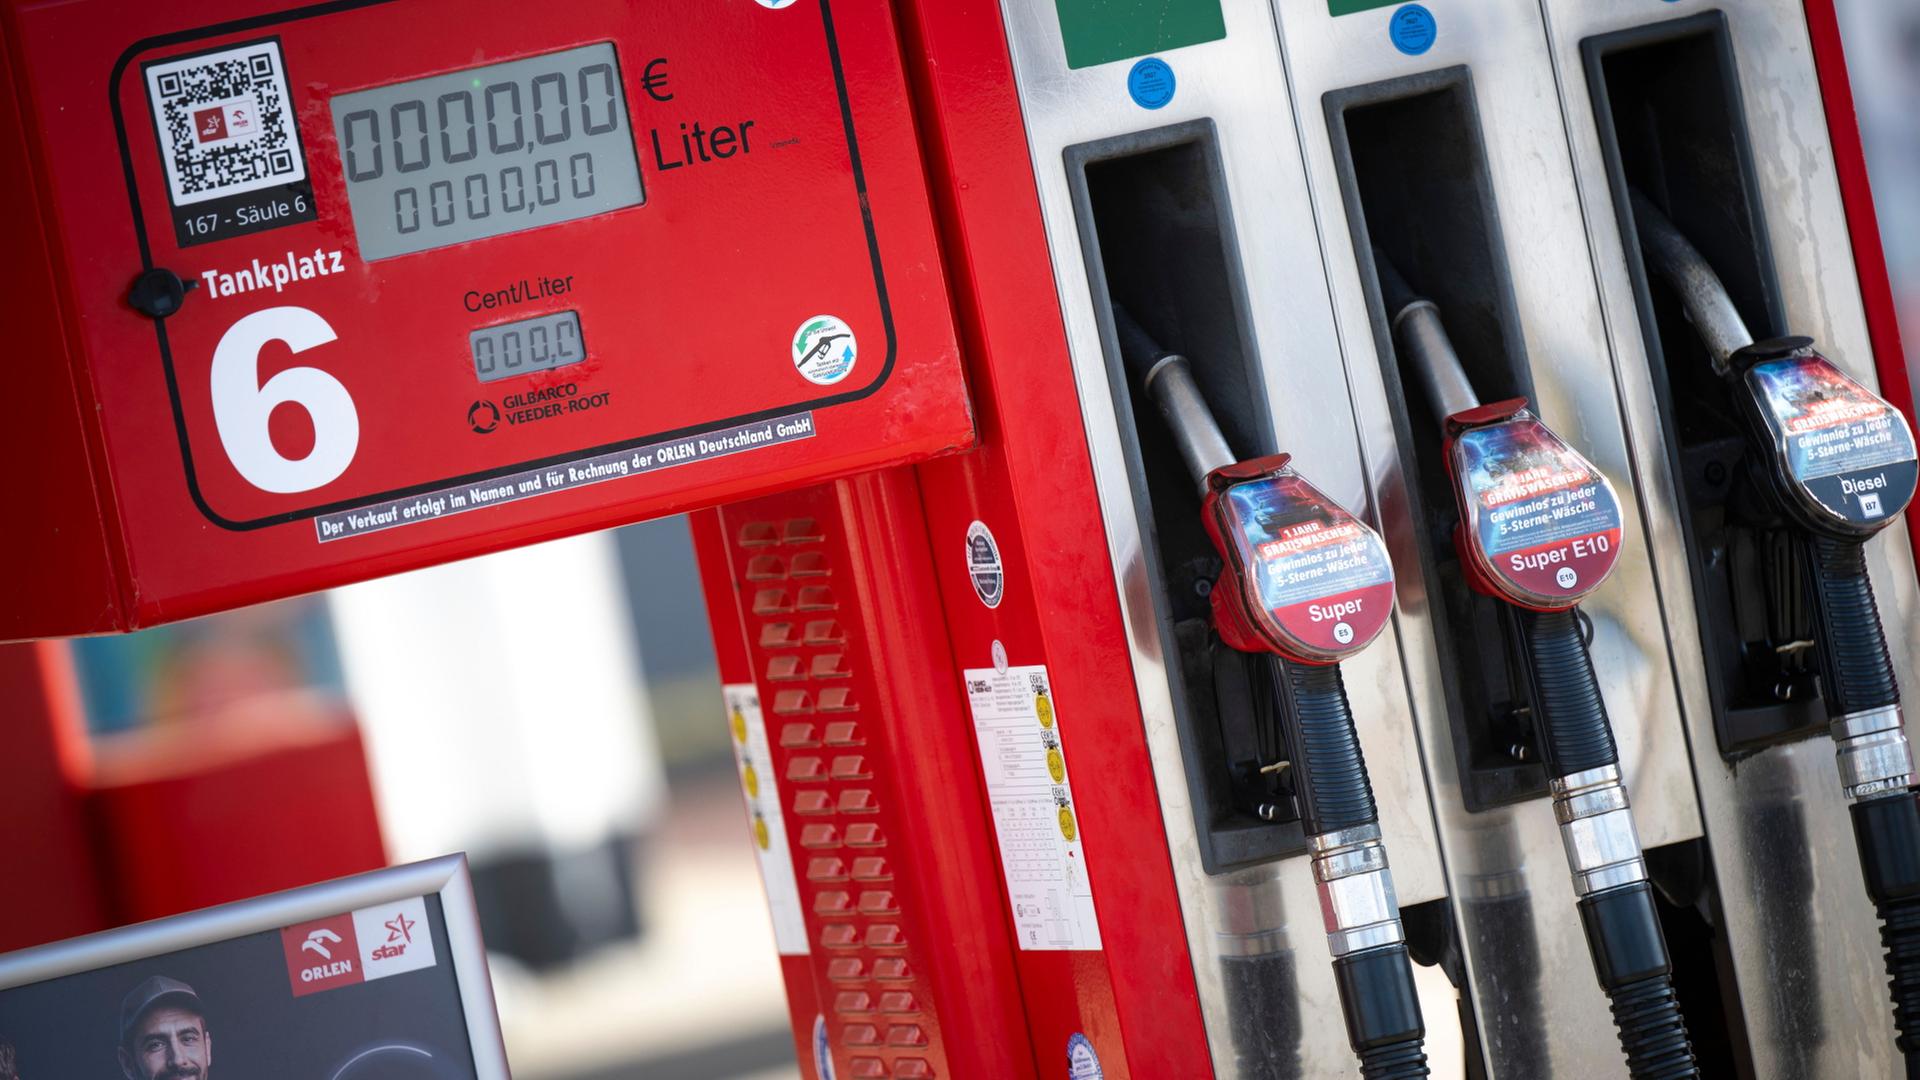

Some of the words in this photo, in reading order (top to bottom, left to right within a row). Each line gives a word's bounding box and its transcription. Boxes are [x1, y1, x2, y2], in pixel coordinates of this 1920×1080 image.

[640, 58, 674, 101] €
[651, 120, 754, 171] Liter
[184, 214, 219, 236] 167
[236, 199, 290, 226] Säule
[294, 195, 307, 214] 6
[202, 248, 345, 299] Tankplatz
[463, 275, 574, 312] Cent/Liter
[210, 306, 360, 494] 6
[503, 383, 577, 409] GILBARCO
[505, 392, 610, 426] VEEDER-ROOT
[1798, 428, 1851, 449] Gewinnlos
[1851, 425, 1865, 436] zu
[1865, 417, 1893, 434] jeder
[1807, 431, 1893, 461] 5-Sterne-Wäsche
[322, 520, 345, 536] Der
[347, 508, 398, 531] Verkauf
[403, 497, 446, 519] erfolgt
[450, 493, 466, 509] im
[470, 484, 515, 504] Namen
[519, 475, 542, 493] und
[546, 469, 565, 488] für
[568, 460, 629, 483] Rechnung
[632, 453, 653, 469] der
[657, 443, 696, 463] ORLEN
[699, 425, 773, 455] Deutschland
[776, 418, 812, 438] GmbH
[1841, 473, 1888, 495] Diesel
[1490, 498, 1550, 524] Gewinnlos
[1551, 494, 1565, 507] zu
[1566, 486, 1597, 504] jeder
[1500, 500, 1597, 535] 5-Sterne-Wäsche
[1865, 501, 1878, 511] B7
[1292, 522, 1321, 537] JAHR
[1267, 553, 1324, 576] Gewinnlos
[1325, 548, 1338, 560] zu
[1338, 541, 1368, 558] jeder
[1510, 545, 1568, 572] Super
[1572, 535, 1610, 560] E10
[1277, 555, 1368, 587] 5-Sterne-Wäsche
[1559, 573, 1575, 583] E10
[1308, 597, 1363, 623] Super
[1338, 628, 1349, 637] E5
[371, 943, 407, 961] star
[301, 960, 352, 982] ORLEN
